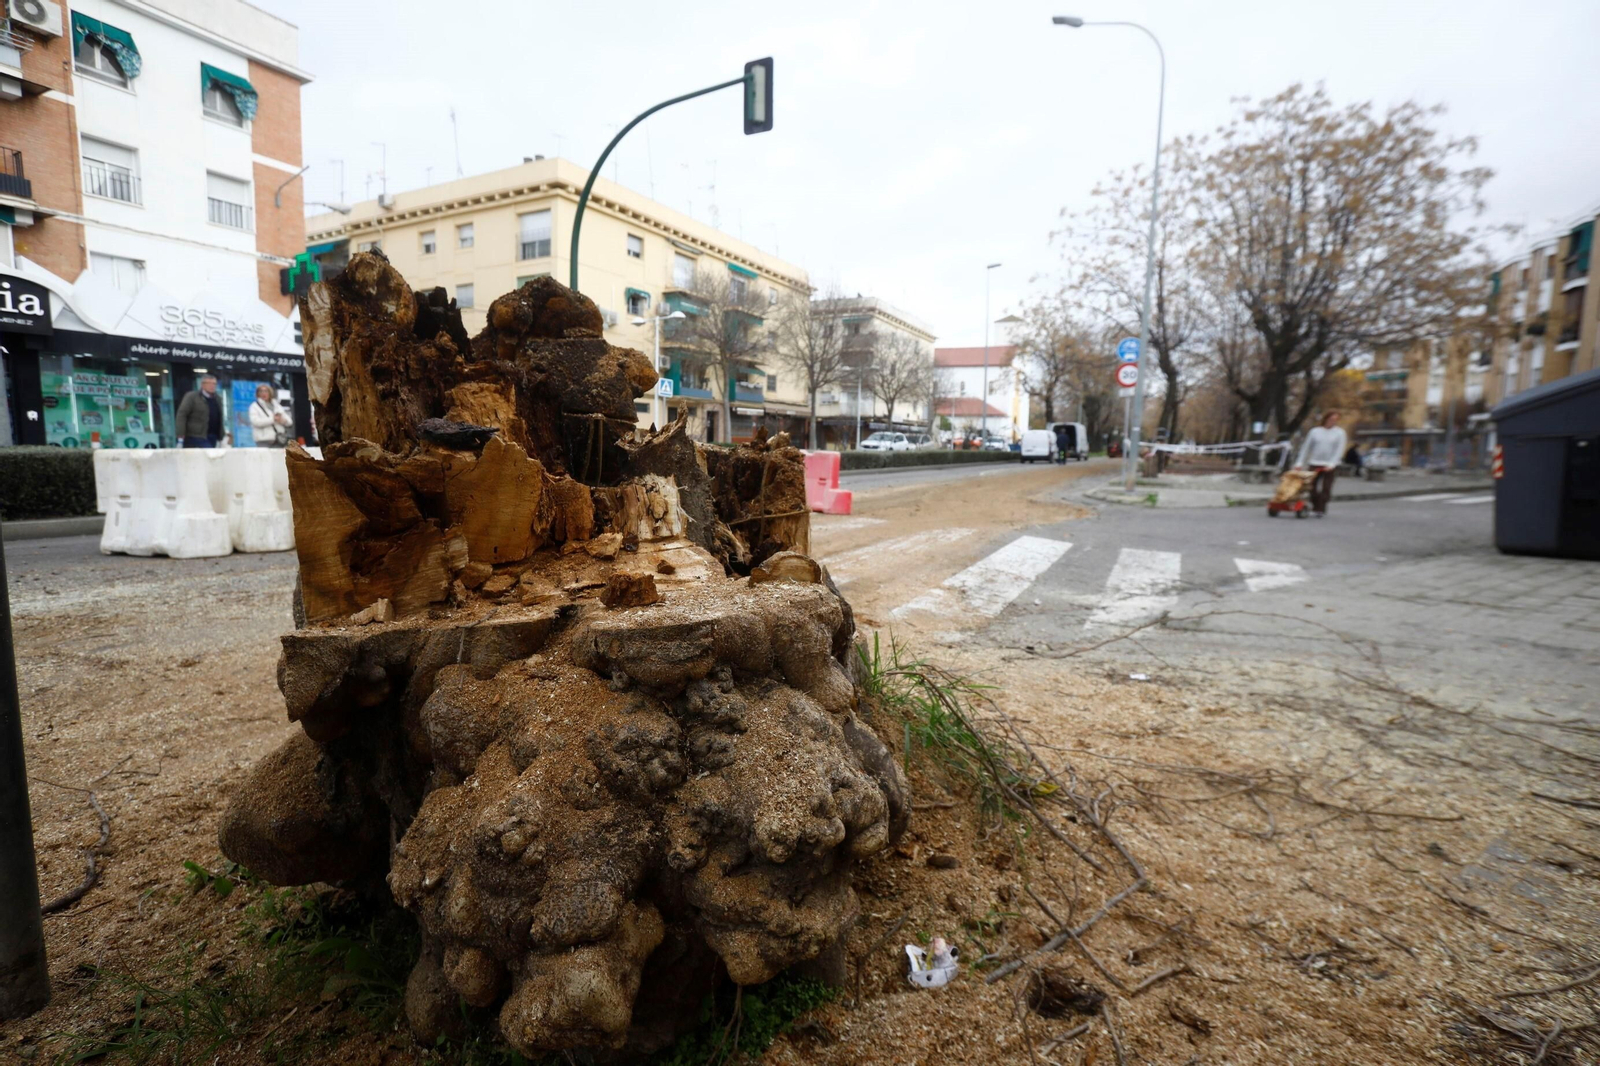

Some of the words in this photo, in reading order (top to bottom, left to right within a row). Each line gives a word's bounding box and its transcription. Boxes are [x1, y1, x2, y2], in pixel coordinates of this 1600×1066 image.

[0, 281, 45, 316] ia
[160, 304, 224, 329] 365
[131, 343, 170, 355] abierto
[172, 347, 198, 358] todos
[199, 349, 213, 359] los
[236, 353, 249, 363] de
[101, 375, 139, 385] NUEVO
[114, 387, 150, 397] NUEVO
